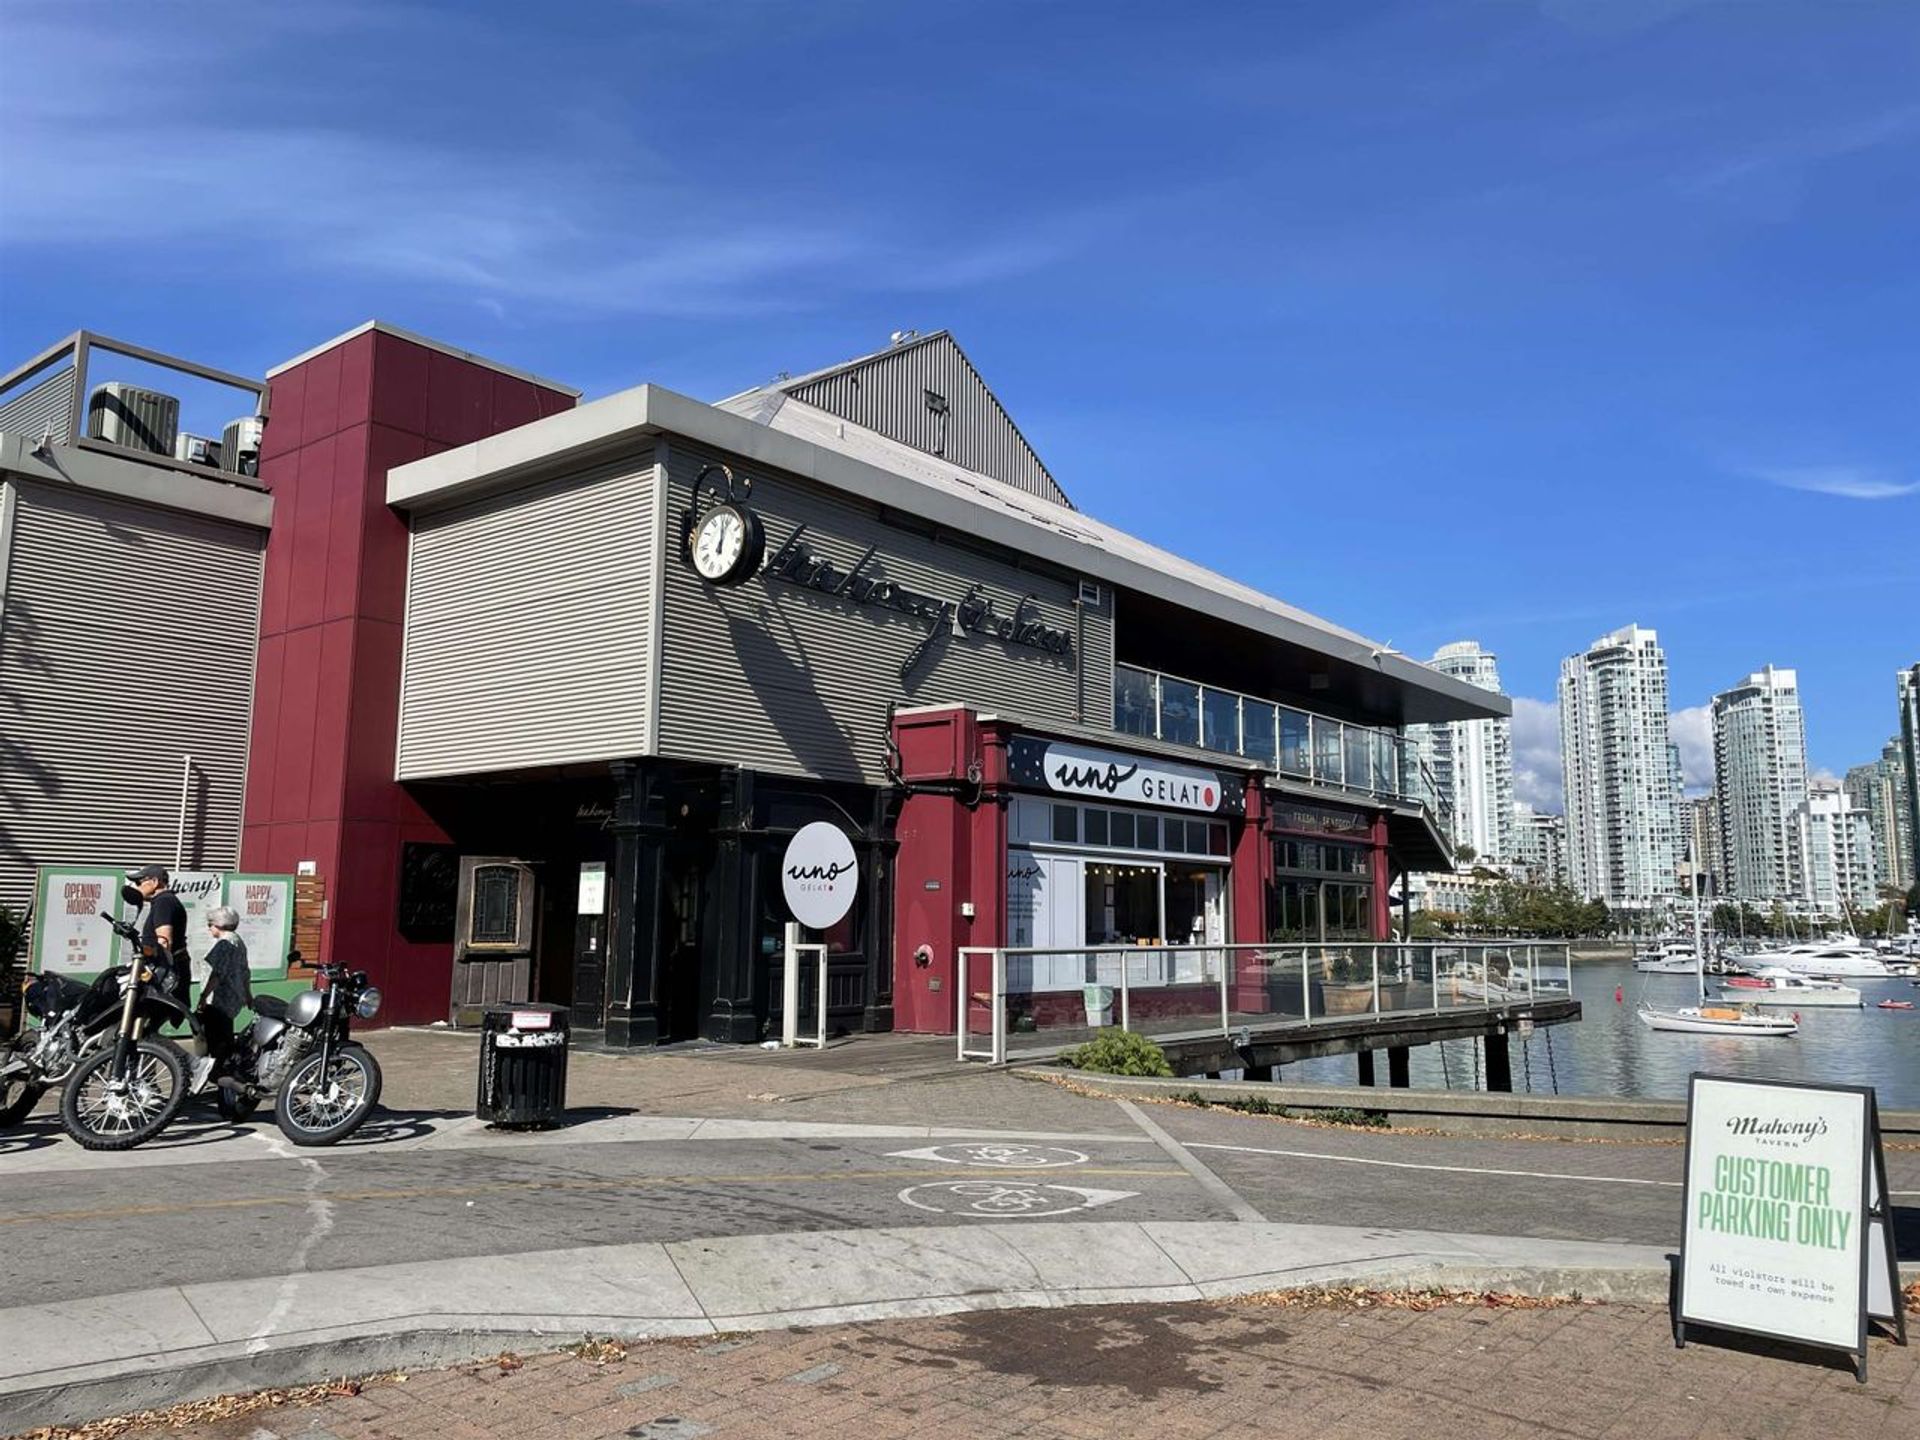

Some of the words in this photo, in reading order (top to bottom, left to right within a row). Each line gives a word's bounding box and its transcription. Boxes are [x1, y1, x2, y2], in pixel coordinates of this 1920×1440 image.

[1055, 763, 1138, 793] uno
[788, 861, 855, 881] uno
[64, 882, 102, 899] OPENING
[168, 874, 221, 900] hony's
[246, 885, 272, 900] HAPPY
[66, 899, 97, 915] HOURS
[247, 900, 268, 915] HOUR
[1726, 1116, 1828, 1143] Mahony's
[1755, 1137, 1799, 1148] TAVERN
[1715, 1154, 1830, 1206] CUSTOMER
[1699, 1191, 1790, 1242] PARKING
[1797, 1205, 1852, 1251] ONLY
[1710, 1264, 1726, 1274] All
[1791, 1278, 1815, 1289] will
[1821, 1282, 1835, 1292] be
[1715, 1276, 1744, 1289] towed
[1766, 1286, 1785, 1296] own
